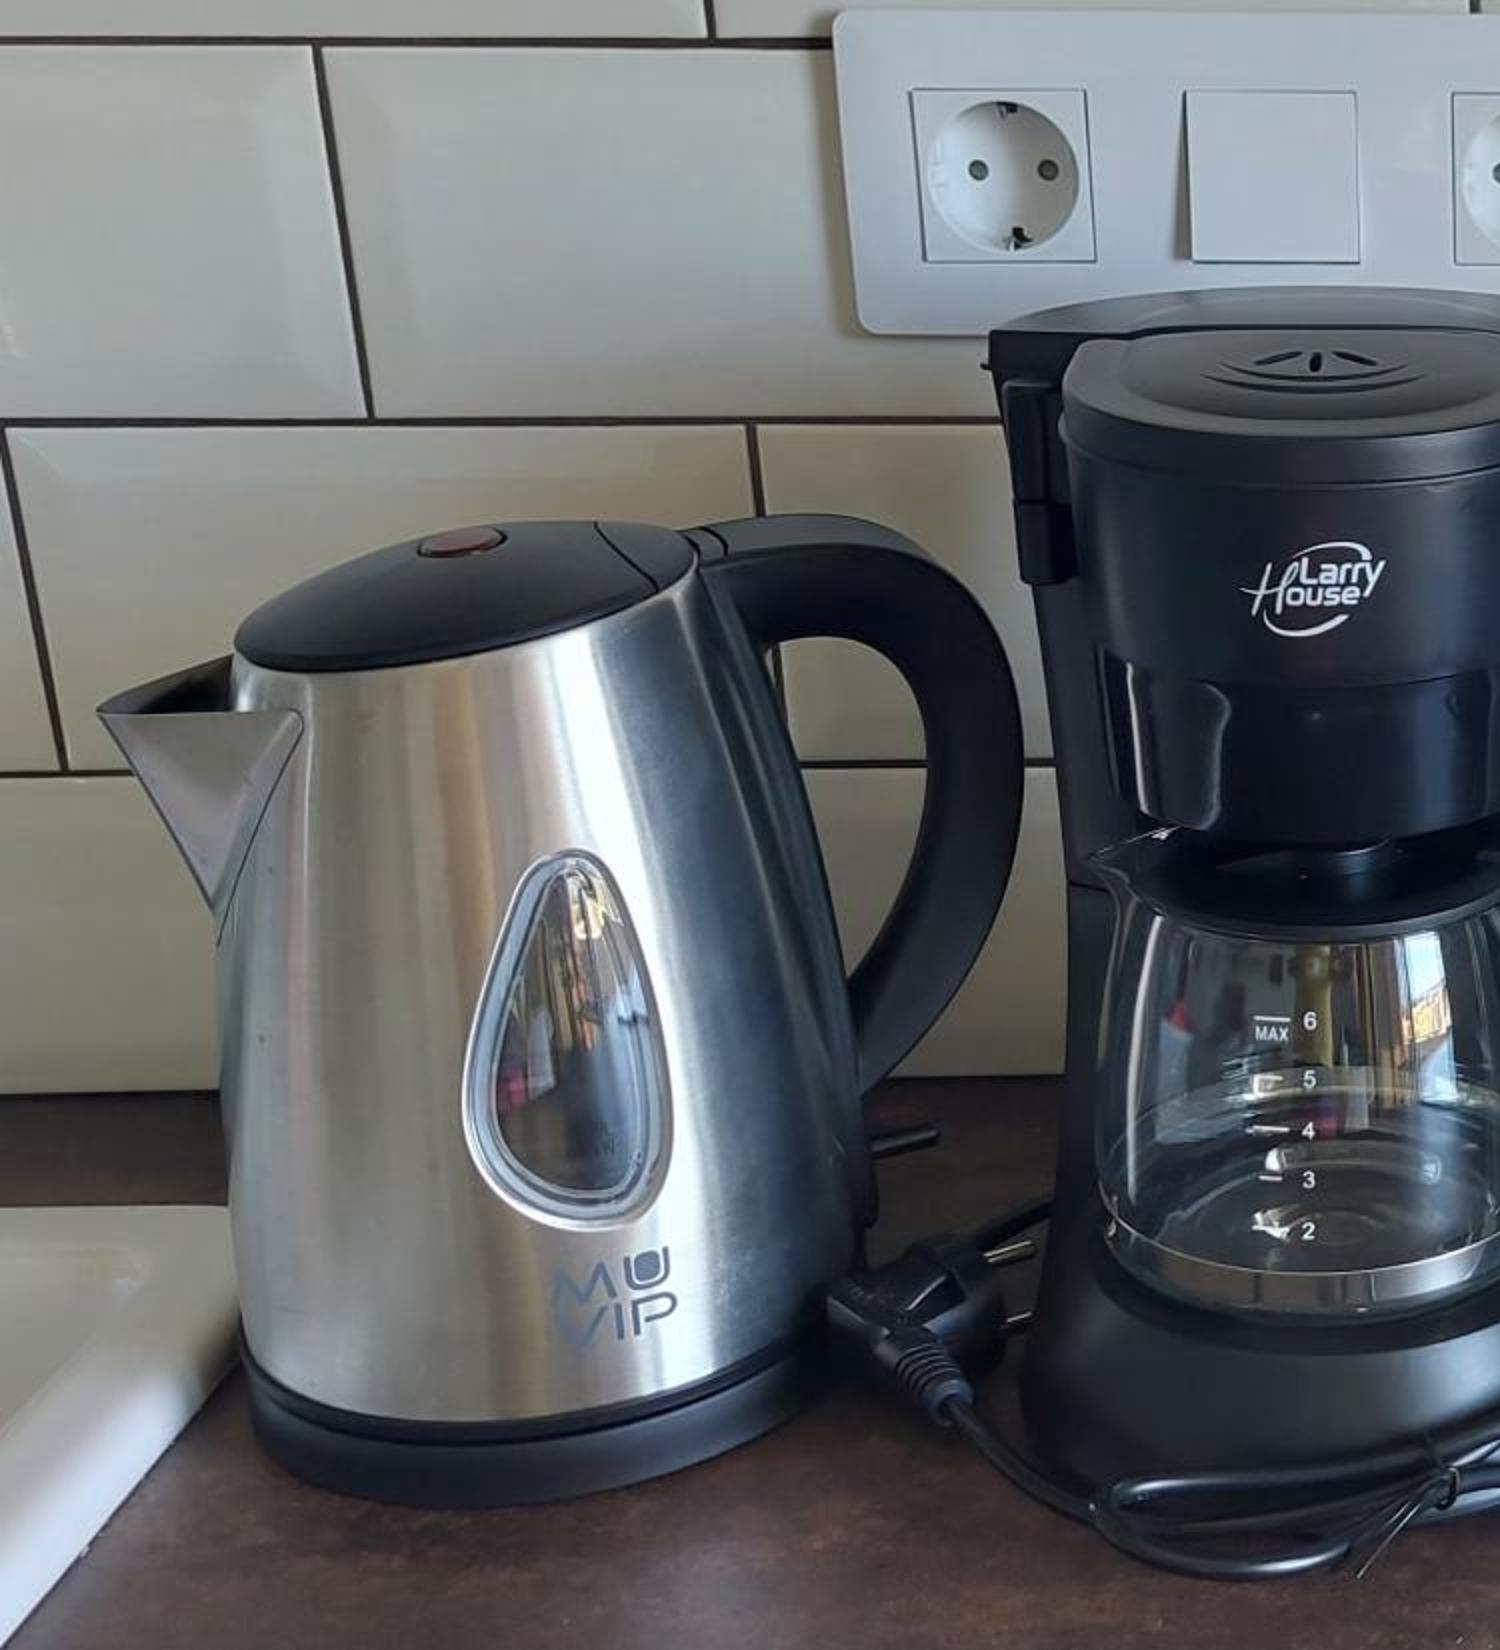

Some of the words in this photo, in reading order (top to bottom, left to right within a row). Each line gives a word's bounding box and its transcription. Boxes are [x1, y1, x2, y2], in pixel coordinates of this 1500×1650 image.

[1299, 556, 1387, 599] Larry
[1238, 560, 1361, 617] House
[1302, 1010, 1318, 1031] 6
[1254, 1024, 1290, 1042] MAX
[1302, 1071, 1317, 1089] 5
[1301, 1120, 1316, 1140] 4
[1302, 1170, 1316, 1189] 3
[1301, 1221, 1316, 1241] 2
[552, 1245, 671, 1303] MU
[553, 1291, 678, 1346] VIP
